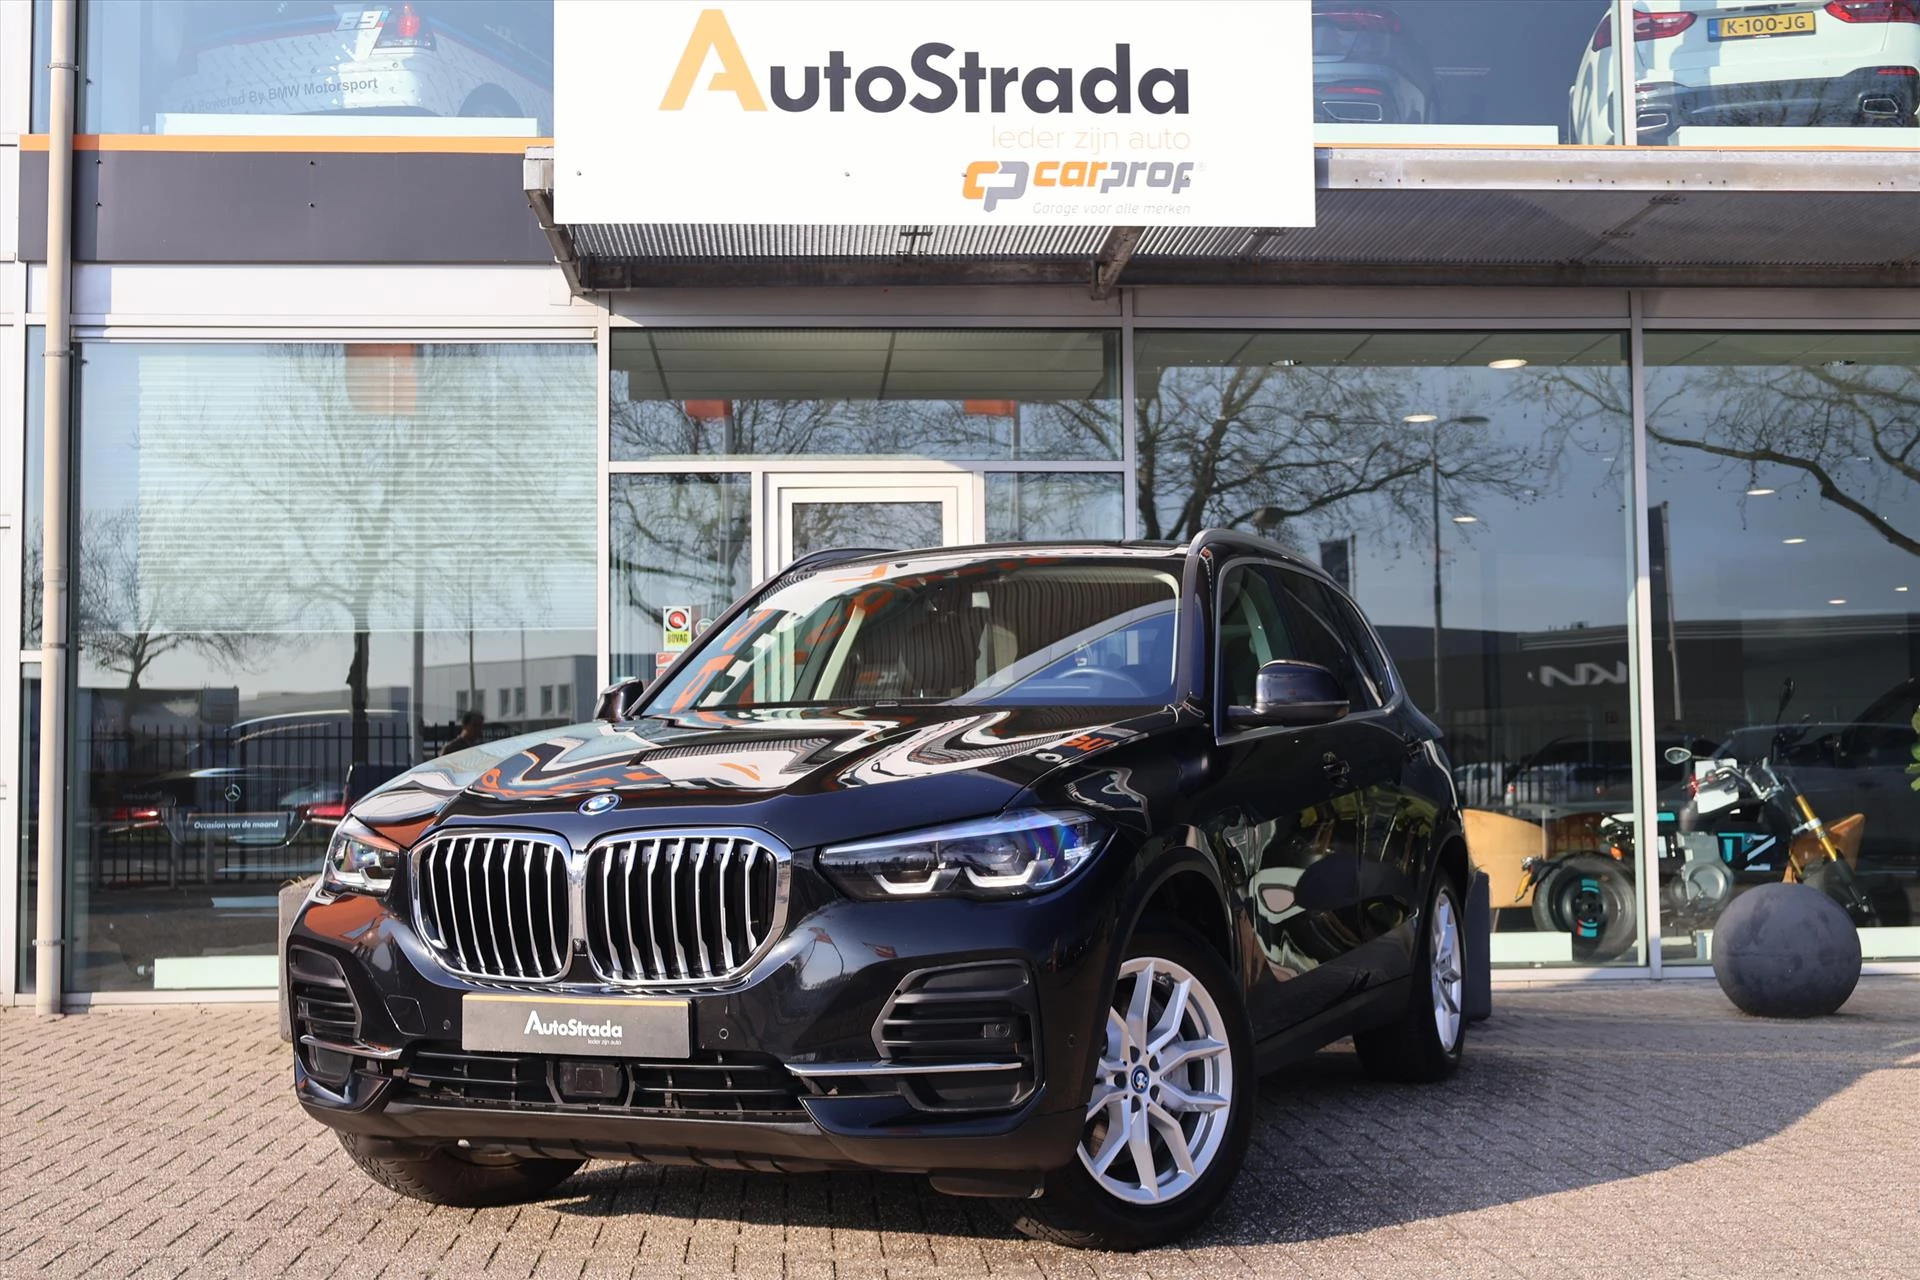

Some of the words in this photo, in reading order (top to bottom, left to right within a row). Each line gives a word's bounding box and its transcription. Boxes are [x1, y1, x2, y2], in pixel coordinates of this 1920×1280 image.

[1727, 15, 1806, 34] K-100-JG
[658, 9, 1190, 114] AutoStrada
[248, 90, 265, 104] By
[268, 84, 300, 100] BMW
[303, 77, 378, 96] Motorsport
[1074, 127, 1118, 154] zijn
[1129, 129, 1191, 150] auto
[1032, 202, 1079, 217] Garage
[1083, 204, 1112, 214] voor
[1115, 202, 1139, 214] alle
[1143, 202, 1191, 215] merken
[193, 820, 226, 830] Occasion
[241, 820, 251, 829] de
[252, 819, 279, 829] maand
[523, 1010, 623, 1038] AutoStrada
